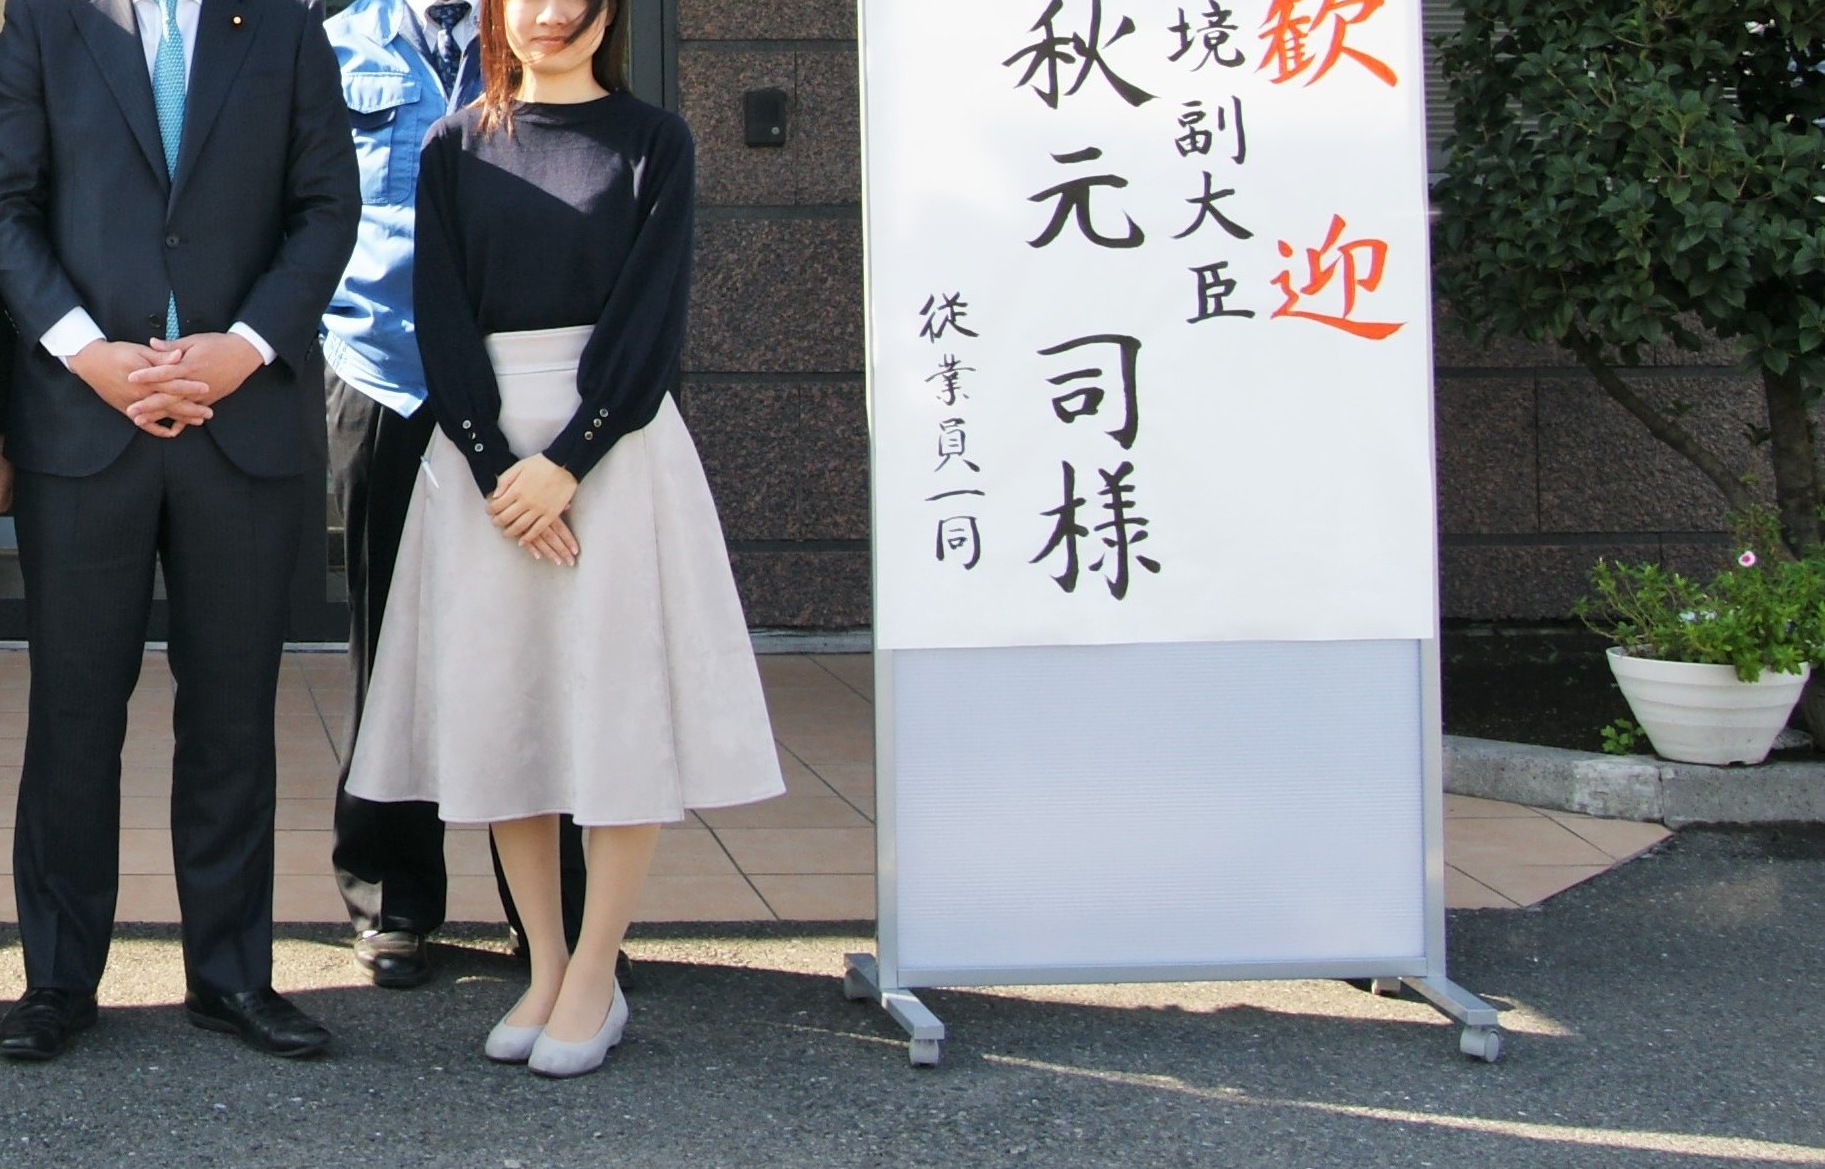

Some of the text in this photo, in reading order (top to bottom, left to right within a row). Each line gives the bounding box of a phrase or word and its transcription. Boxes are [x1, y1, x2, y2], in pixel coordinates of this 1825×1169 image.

[918, 291, 987, 571] 従業員一同
